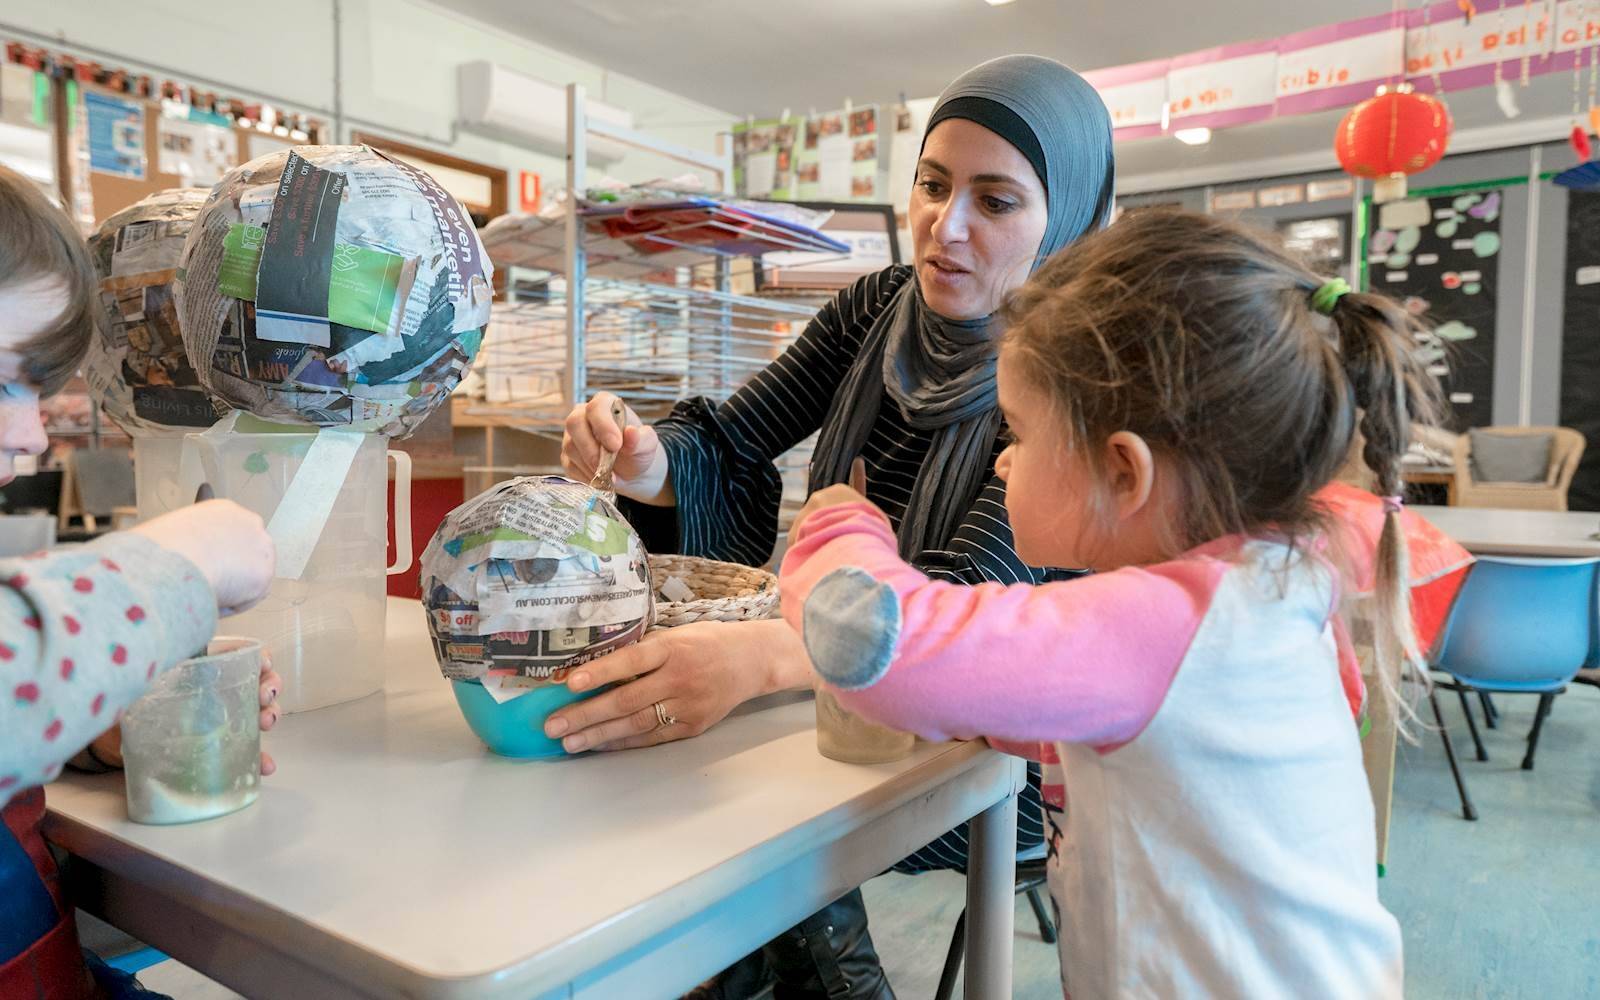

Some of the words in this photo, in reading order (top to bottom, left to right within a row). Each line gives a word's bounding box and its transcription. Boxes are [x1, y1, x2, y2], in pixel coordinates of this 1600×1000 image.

[280, 185, 289, 196] on
[285, 152, 299, 184] selected
[301, 165, 309, 176] on
[331, 180, 343, 195] Offer
[447, 207, 472, 263] even
[521, 513, 558, 530] AUSTRALIAN
[455, 614, 473, 624] off
[525, 665, 562, 678] OWN
